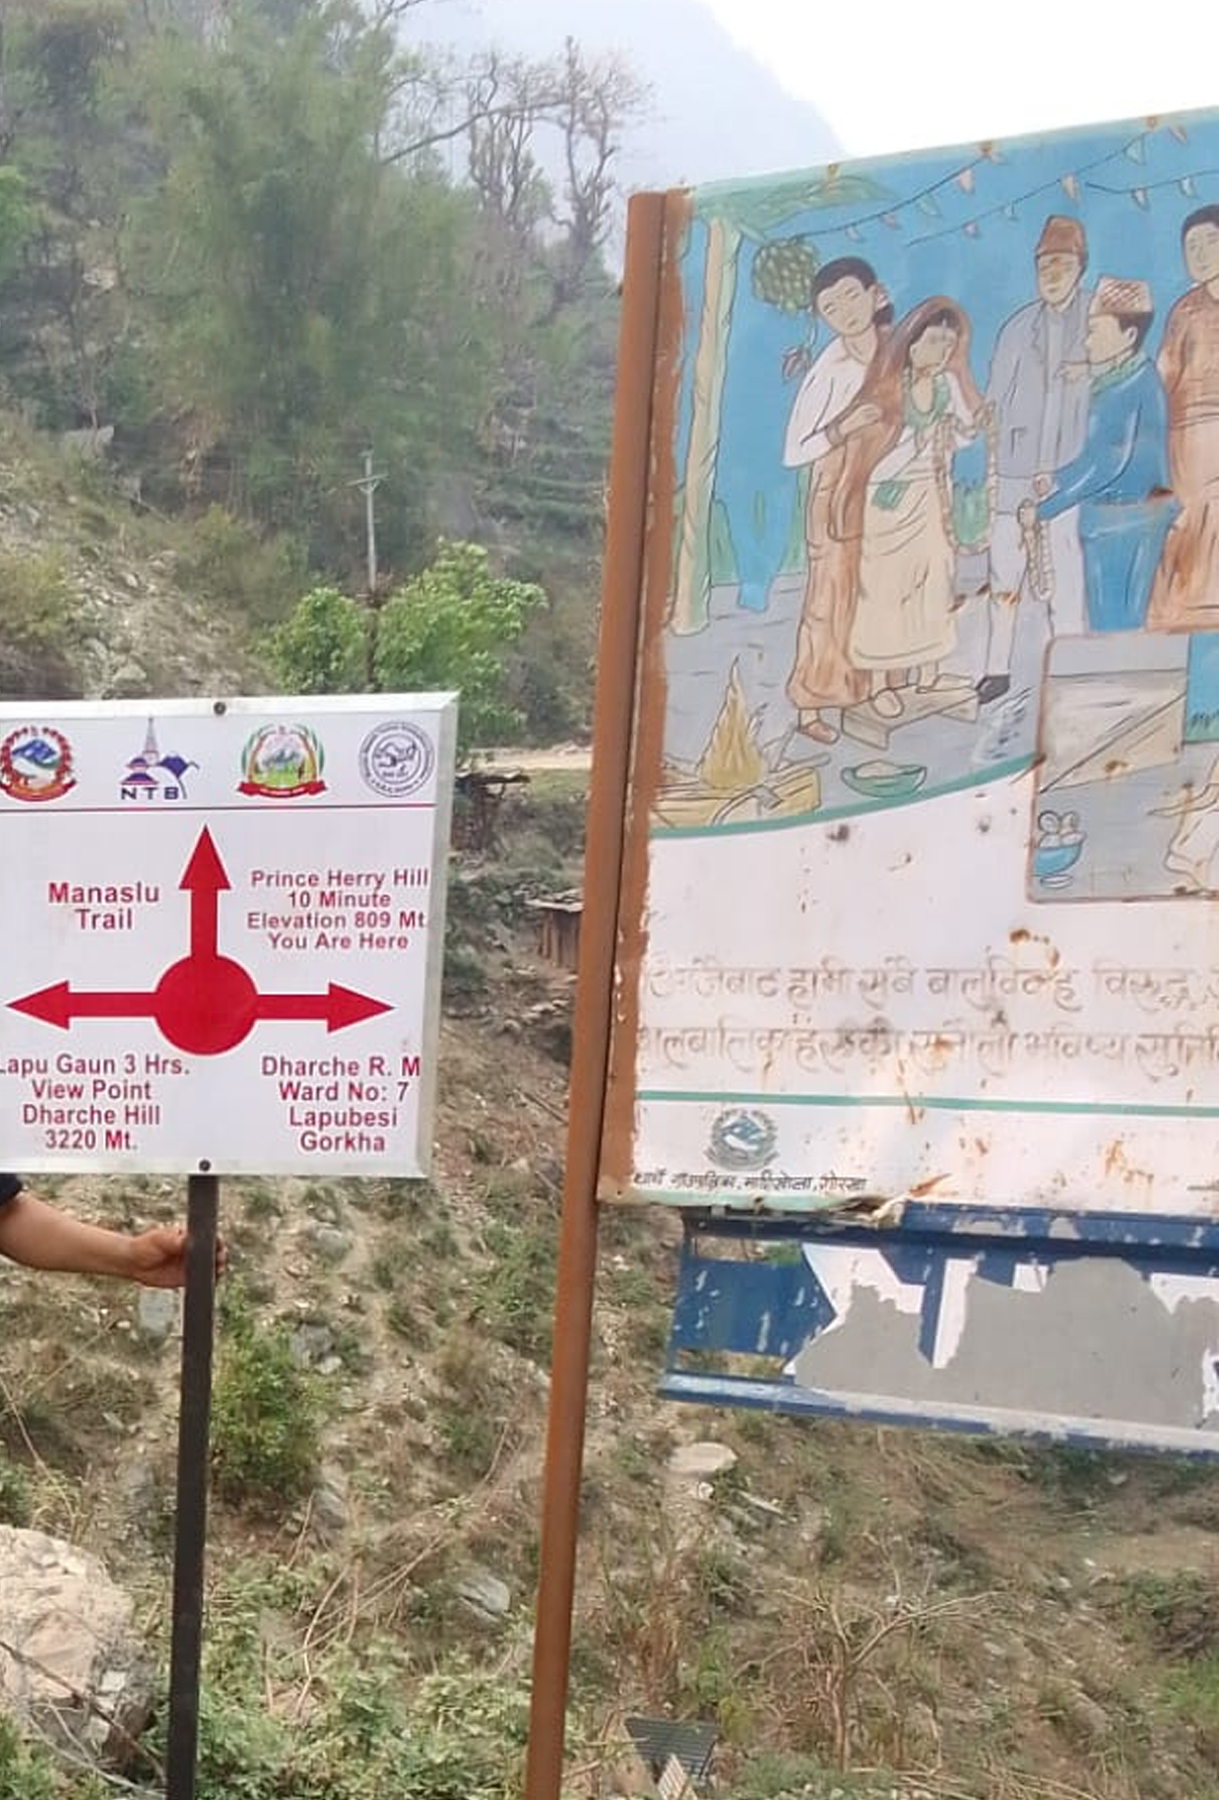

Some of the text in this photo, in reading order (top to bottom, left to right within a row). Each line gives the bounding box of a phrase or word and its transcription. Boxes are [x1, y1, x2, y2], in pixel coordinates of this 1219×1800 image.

[121, 787, 179, 800] NTB
[251, 868, 429, 890] Prince Herry Hill
[48, 881, 159, 903] Manaslu
[289, 891, 391, 908] 10 Minute
[74, 908, 132, 930] Trail
[247, 911, 427, 929] Elevation 809 Mt
[269, 932, 409, 949] You Are Here
[56, 1054, 115, 1075] Gaun
[124, 1054, 136, 1075] 3
[145, 1054, 190, 1075] Hrs.
[262, 1056, 421, 1077] Dharche R. M
[32, 1079, 151, 1100] View Point
[279, 1081, 410, 1101] Ward No: 7
[23, 1104, 160, 1124] Dharche Hill
[290, 1106, 398, 1131] Lapubesi
[45, 1129, 138, 1150] 3220 Mt.
[300, 1131, 385, 1151] Gorkha
